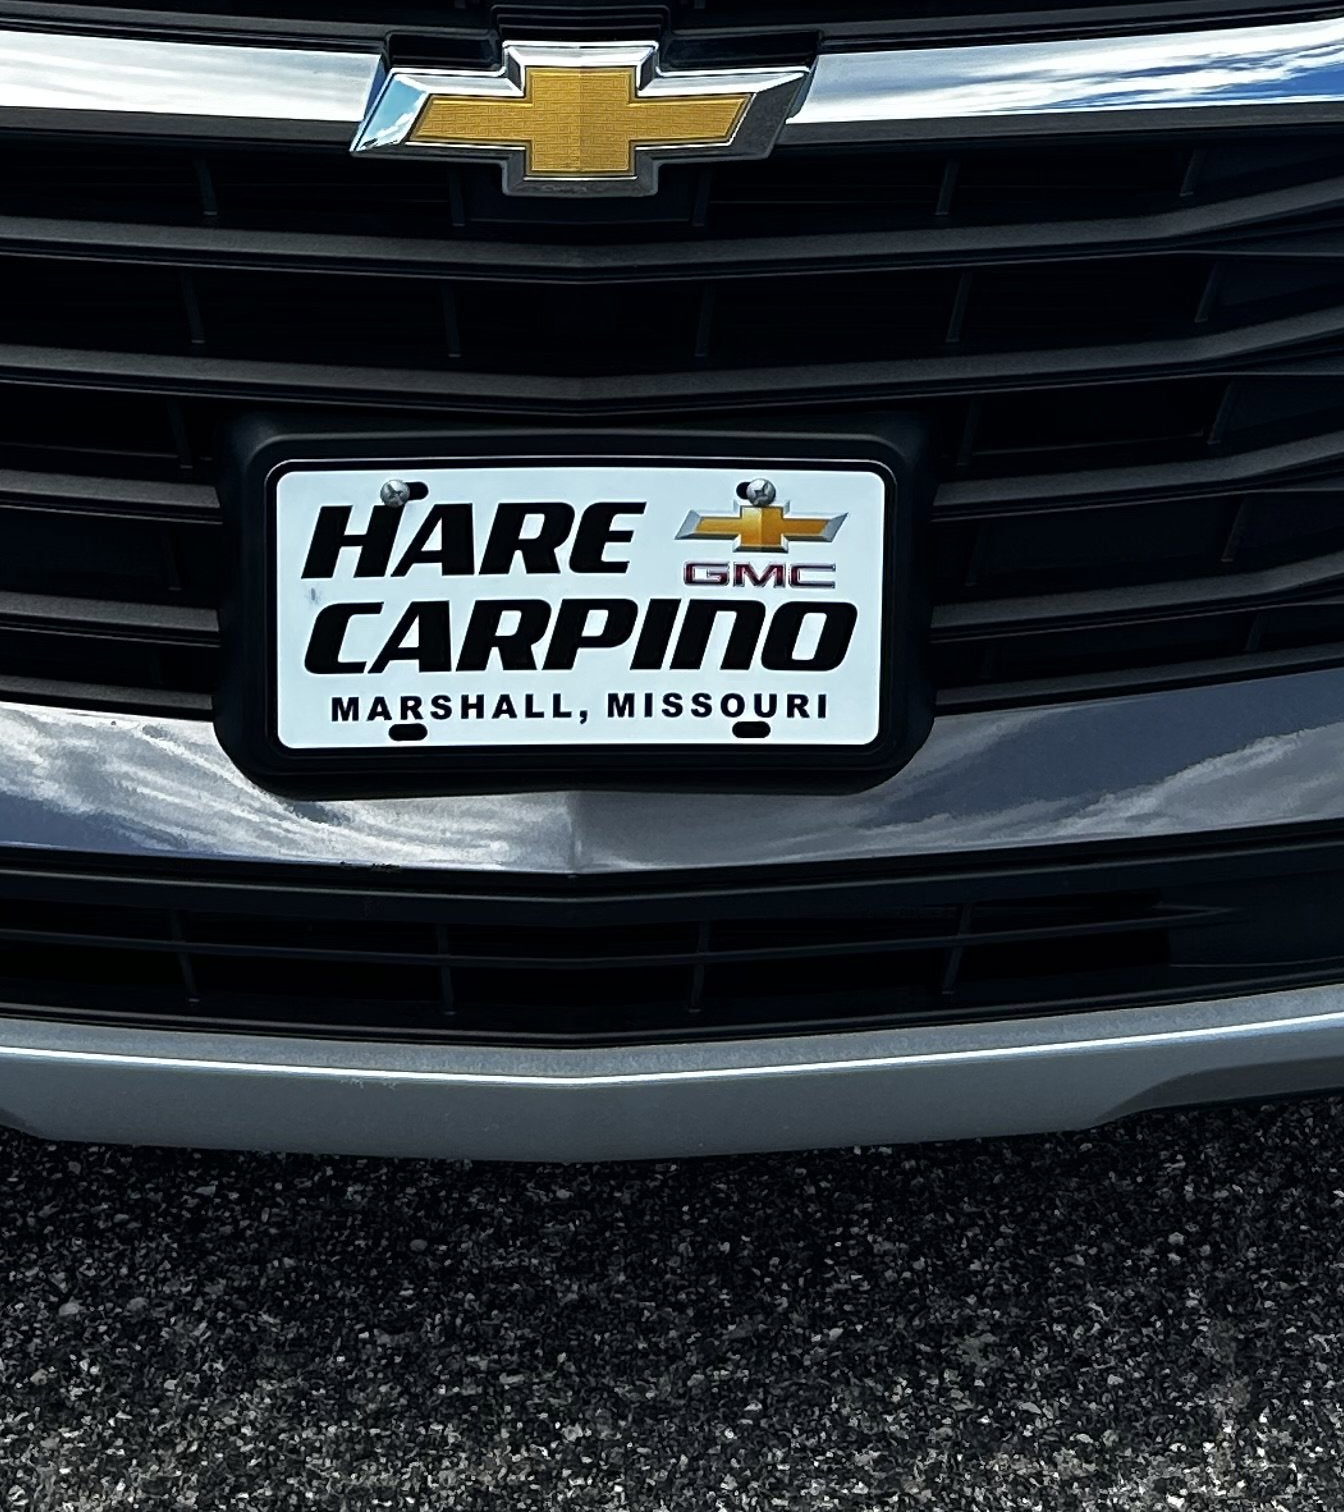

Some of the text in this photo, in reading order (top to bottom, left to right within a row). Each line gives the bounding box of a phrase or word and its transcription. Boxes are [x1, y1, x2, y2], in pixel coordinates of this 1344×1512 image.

[300, 500, 647, 579] HARE
[682, 561, 837, 590] GMC
[304, 598, 858, 675] CARPINO
[331, 692, 827, 725] MARSHALL, MISSOURI
